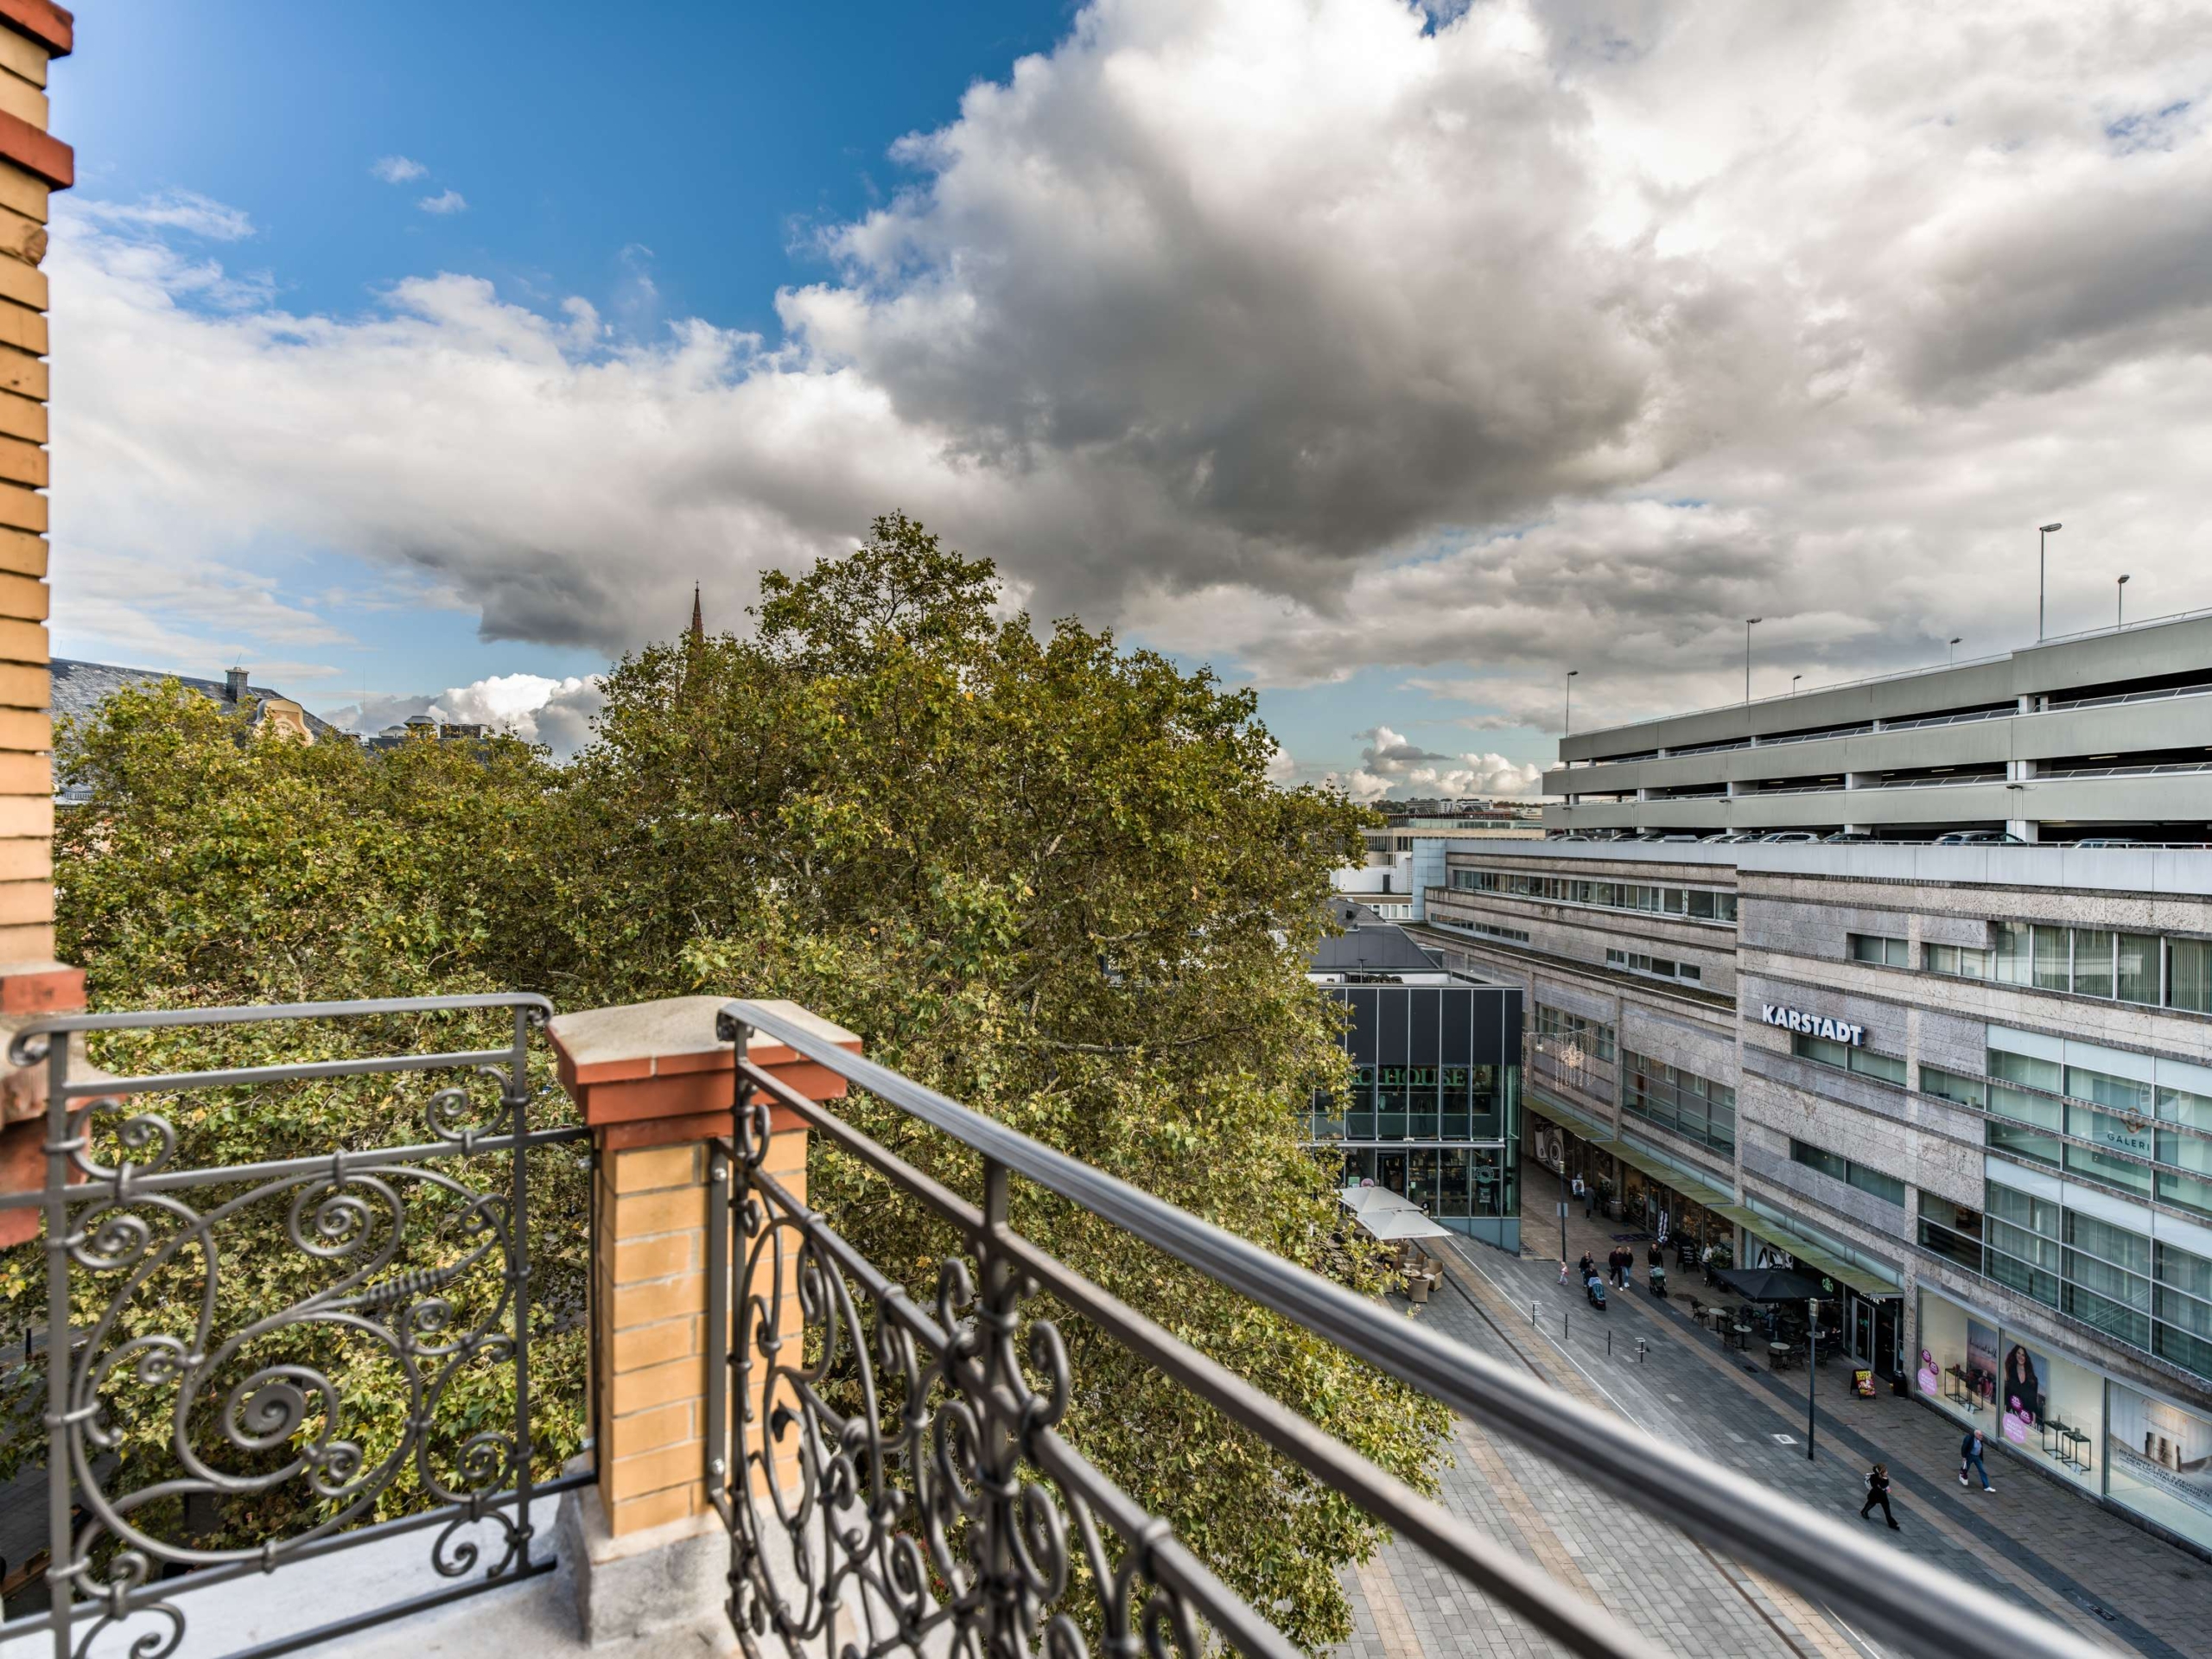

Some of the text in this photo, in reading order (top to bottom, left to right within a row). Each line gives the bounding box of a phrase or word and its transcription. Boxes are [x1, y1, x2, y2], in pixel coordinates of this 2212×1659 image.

[1763, 1004, 1862, 1046] KARSTADT
[1382, 1068, 1465, 1086] HOUSE
[2107, 1133, 2150, 1151] GALERI
[2126, 1457, 2141, 1467] DER
[2177, 1478, 2210, 1497] ZEICHEN
